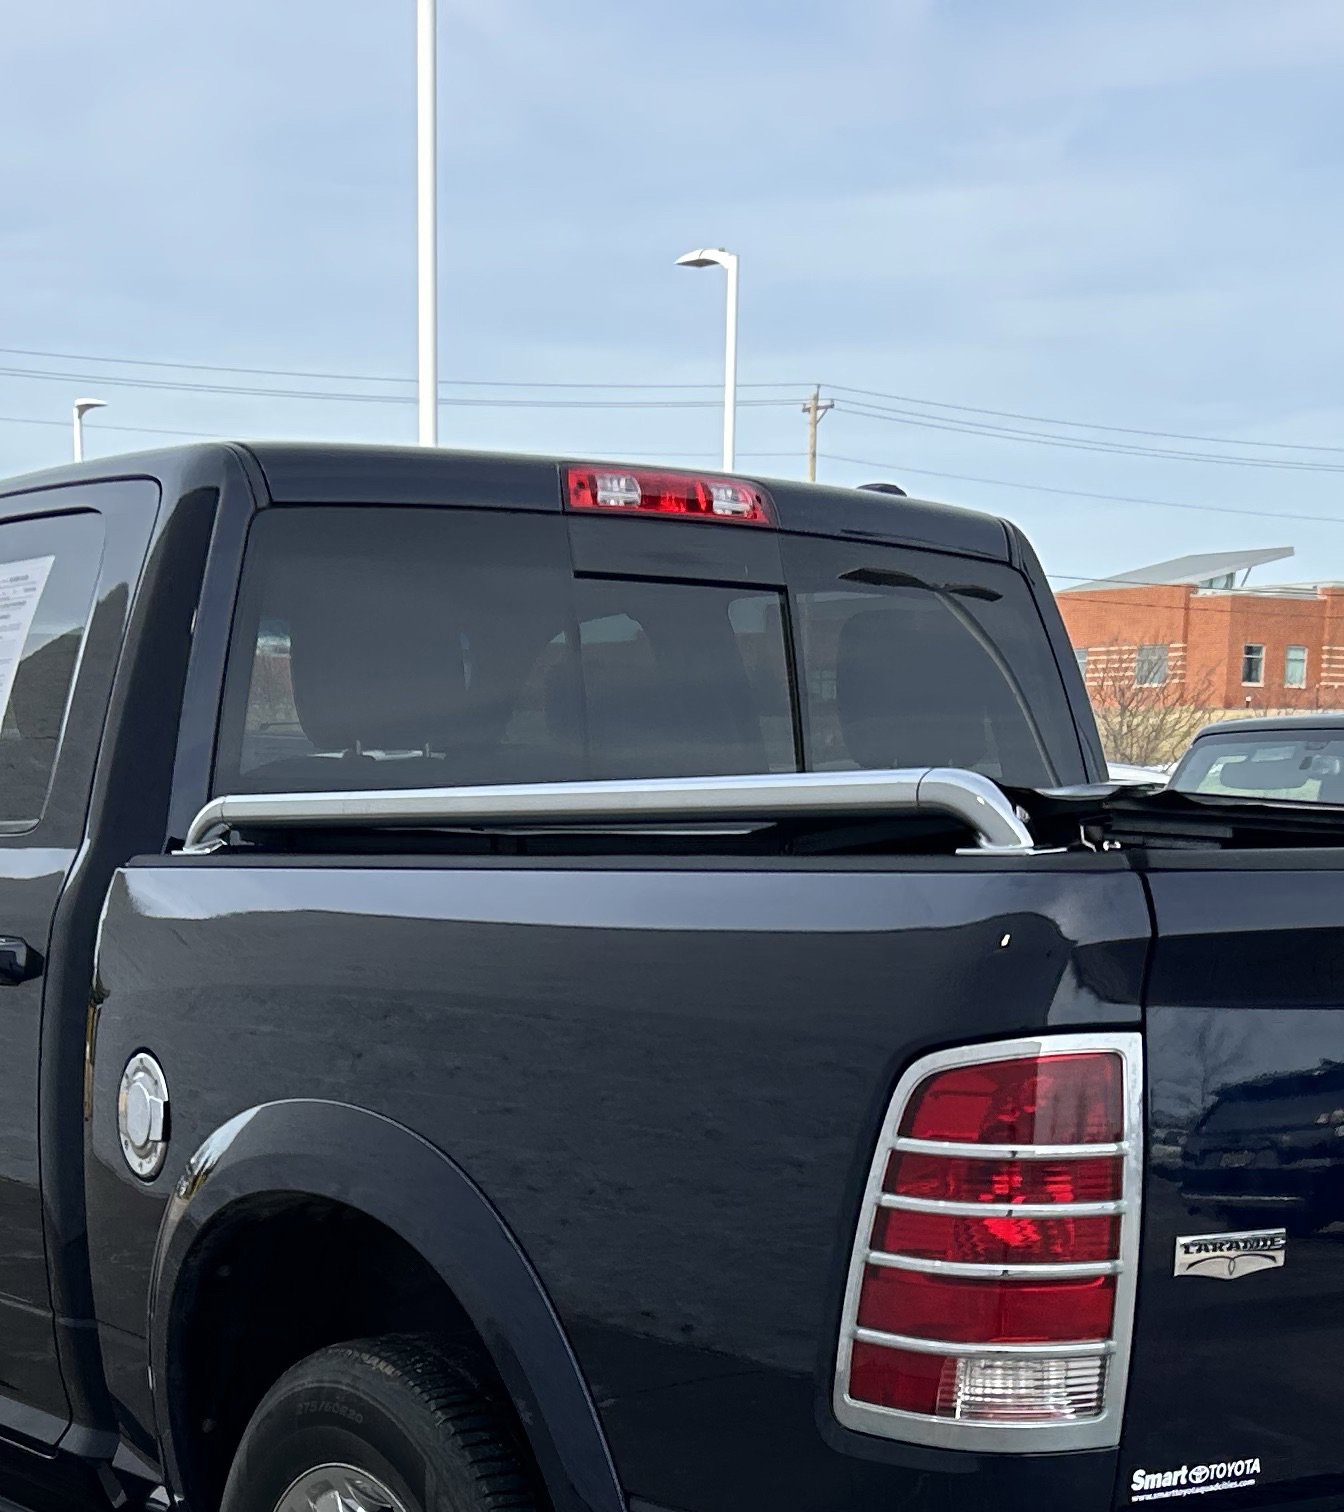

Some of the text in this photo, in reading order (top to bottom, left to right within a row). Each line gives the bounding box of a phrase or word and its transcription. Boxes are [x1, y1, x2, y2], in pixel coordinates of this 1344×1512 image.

[1180, 1237, 1286, 1255] LARAMIE
[1130, 1457, 1262, 1491] Smart TOYOTA
